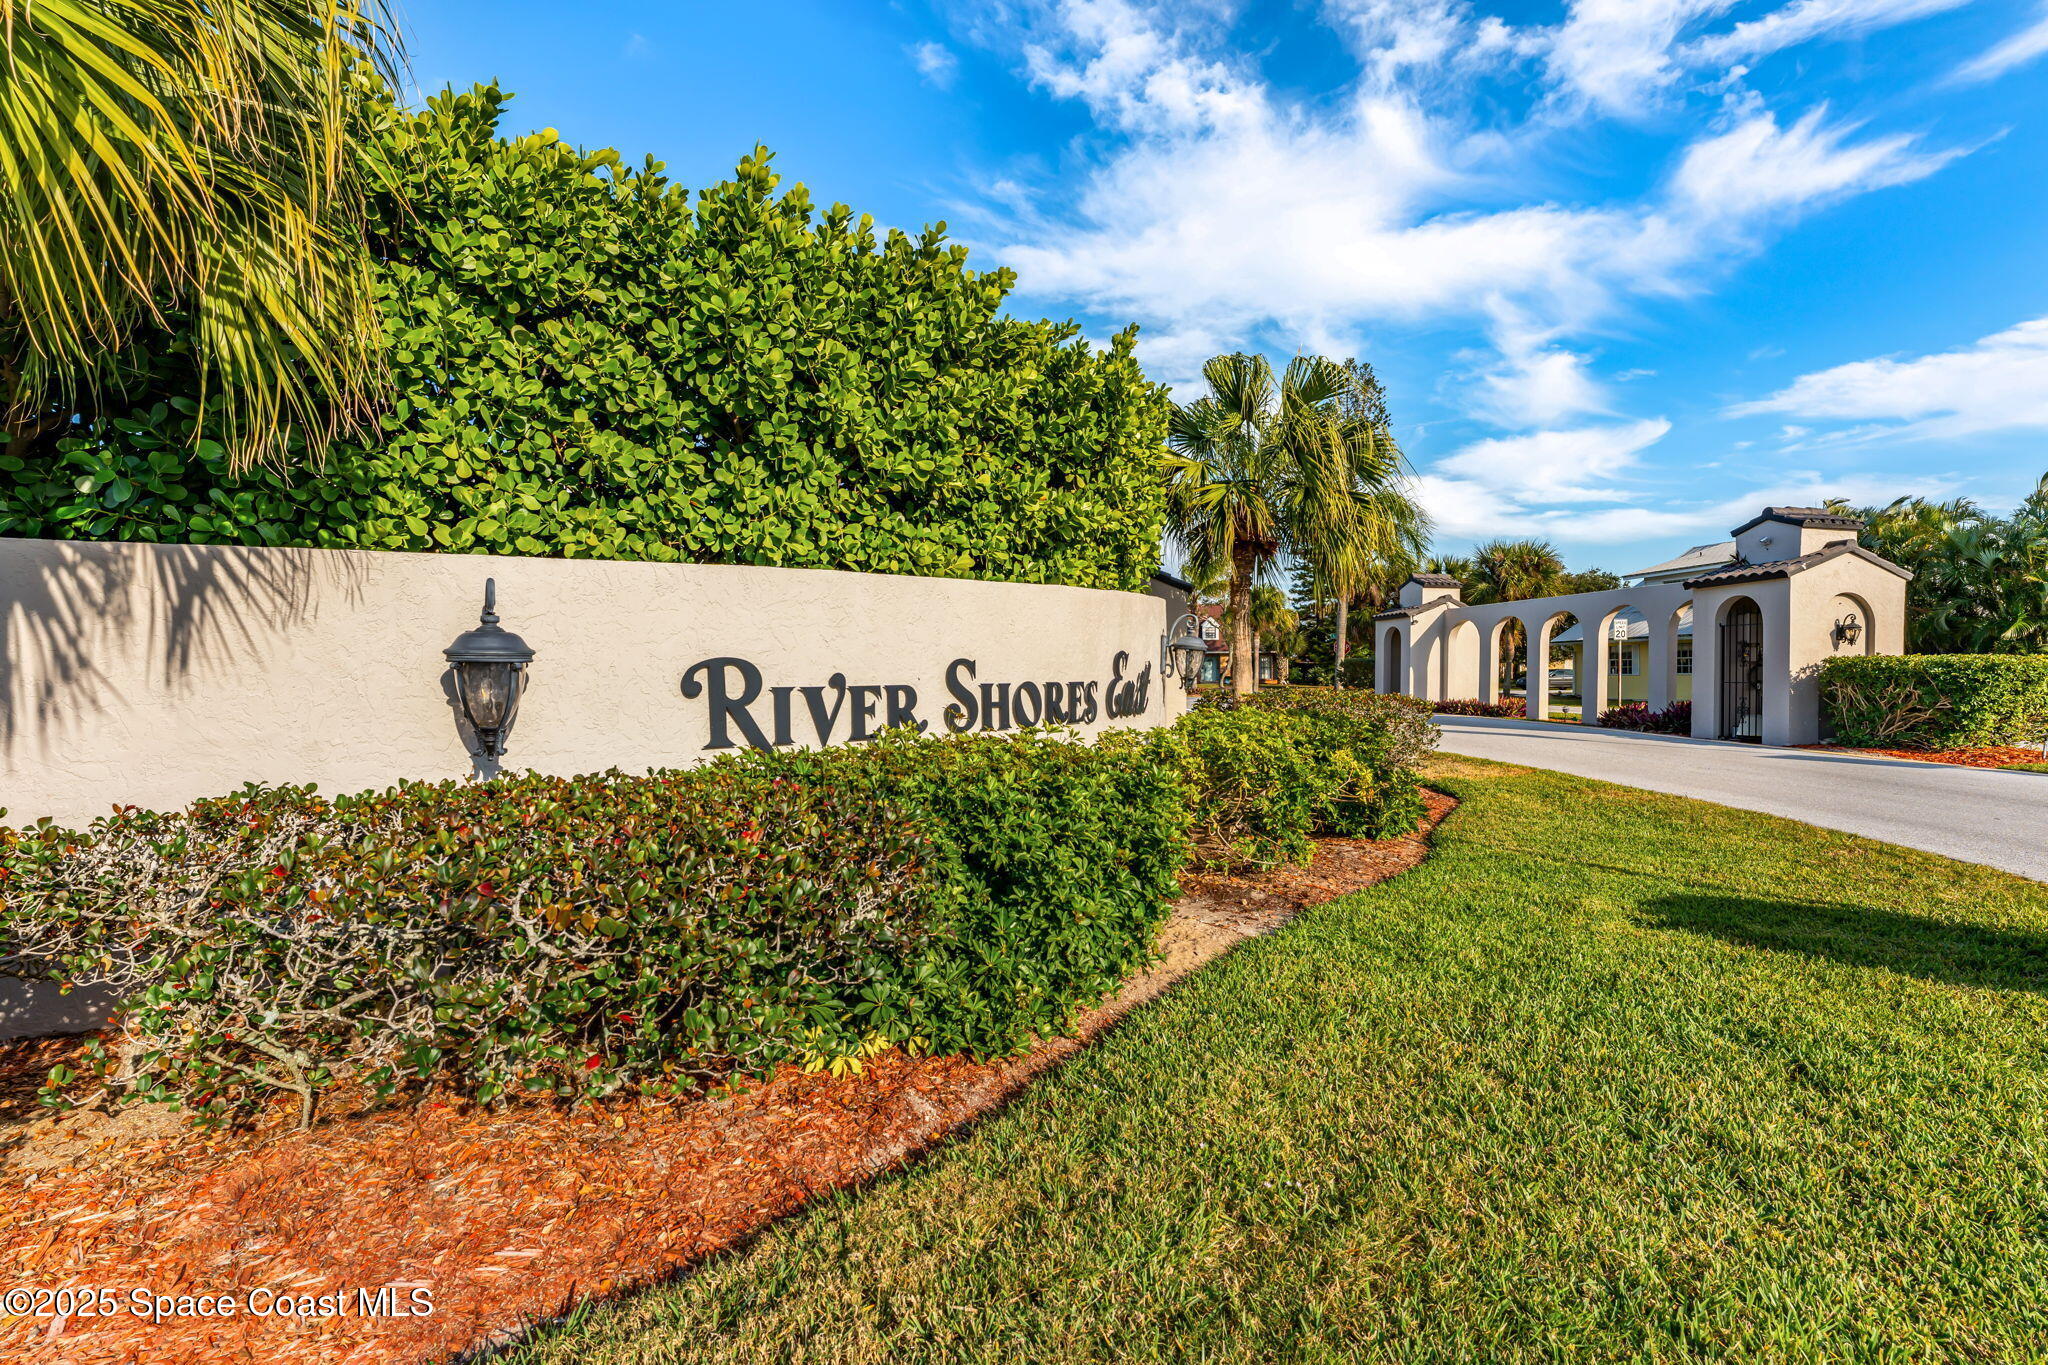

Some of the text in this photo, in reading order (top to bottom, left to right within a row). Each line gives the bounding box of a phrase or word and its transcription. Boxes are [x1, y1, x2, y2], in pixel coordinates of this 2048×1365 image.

[1615, 629, 1626, 638] 20
[680, 650, 1151, 754] RIVER SHORES East
